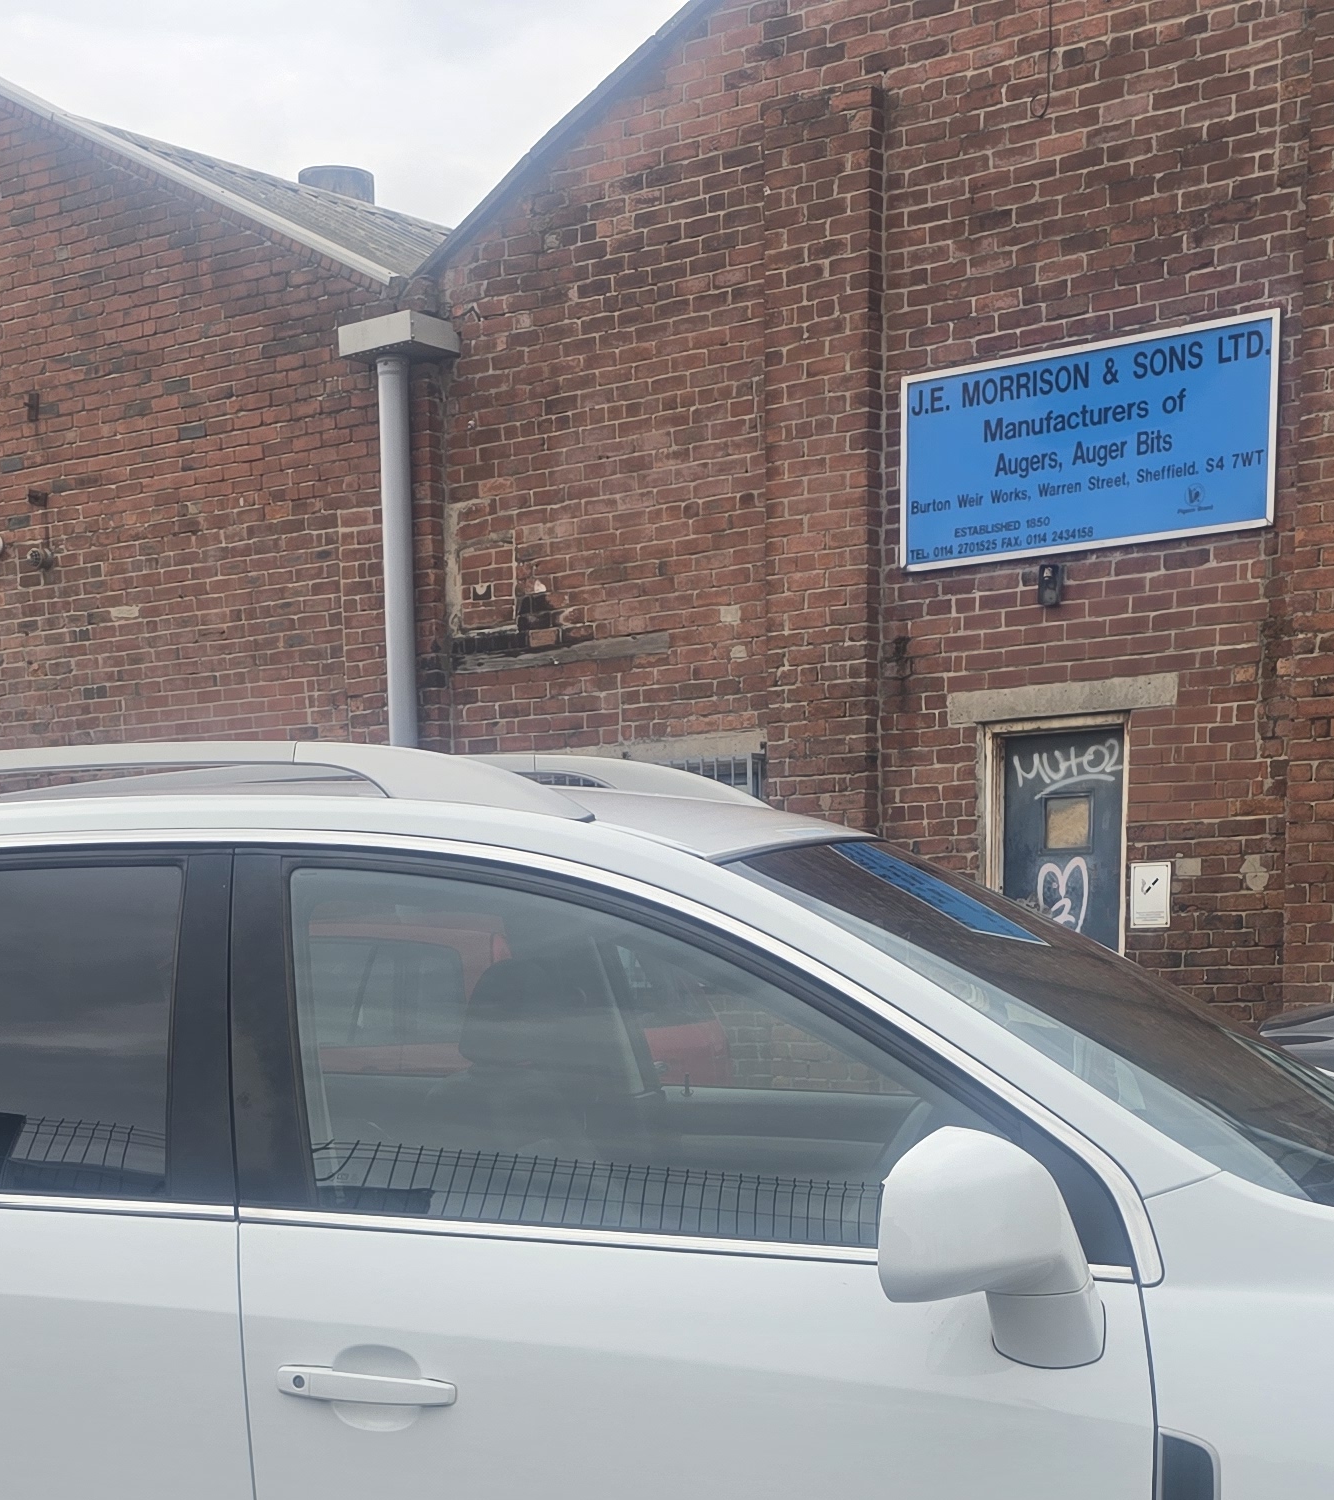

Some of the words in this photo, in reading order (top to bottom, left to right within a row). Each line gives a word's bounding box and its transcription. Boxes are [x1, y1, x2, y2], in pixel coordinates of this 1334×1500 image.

[911, 386, 950, 416] J.E.
[962, 361, 1090, 408] MORRISON
[1102, 357, 1120, 386] &
[1133, 341, 1204, 380] SONS
[1218, 329, 1271, 365] LTD.
[983, 399, 1150, 443] Manufacturers
[1162, 387, 1187, 414] of
[994, 451, 1063, 479] Augers,
[1072, 440, 1128, 468] Auger
[1136, 430, 1173, 456] Bits
[910, 499, 951, 515] Burton
[957, 493, 984, 509] Weir
[1038, 481, 1082, 498] Warren
[1087, 472, 1130, 491] Street,
[1205, 456, 1225, 473] S4
[1232, 449, 1265, 469] 7WT
[933, 544, 954, 558] 0114
[1026, 532, 1048, 546] 0114
[954, 520, 1021, 538] ESTABLISHED
[1026, 515, 1051, 529] 1850
